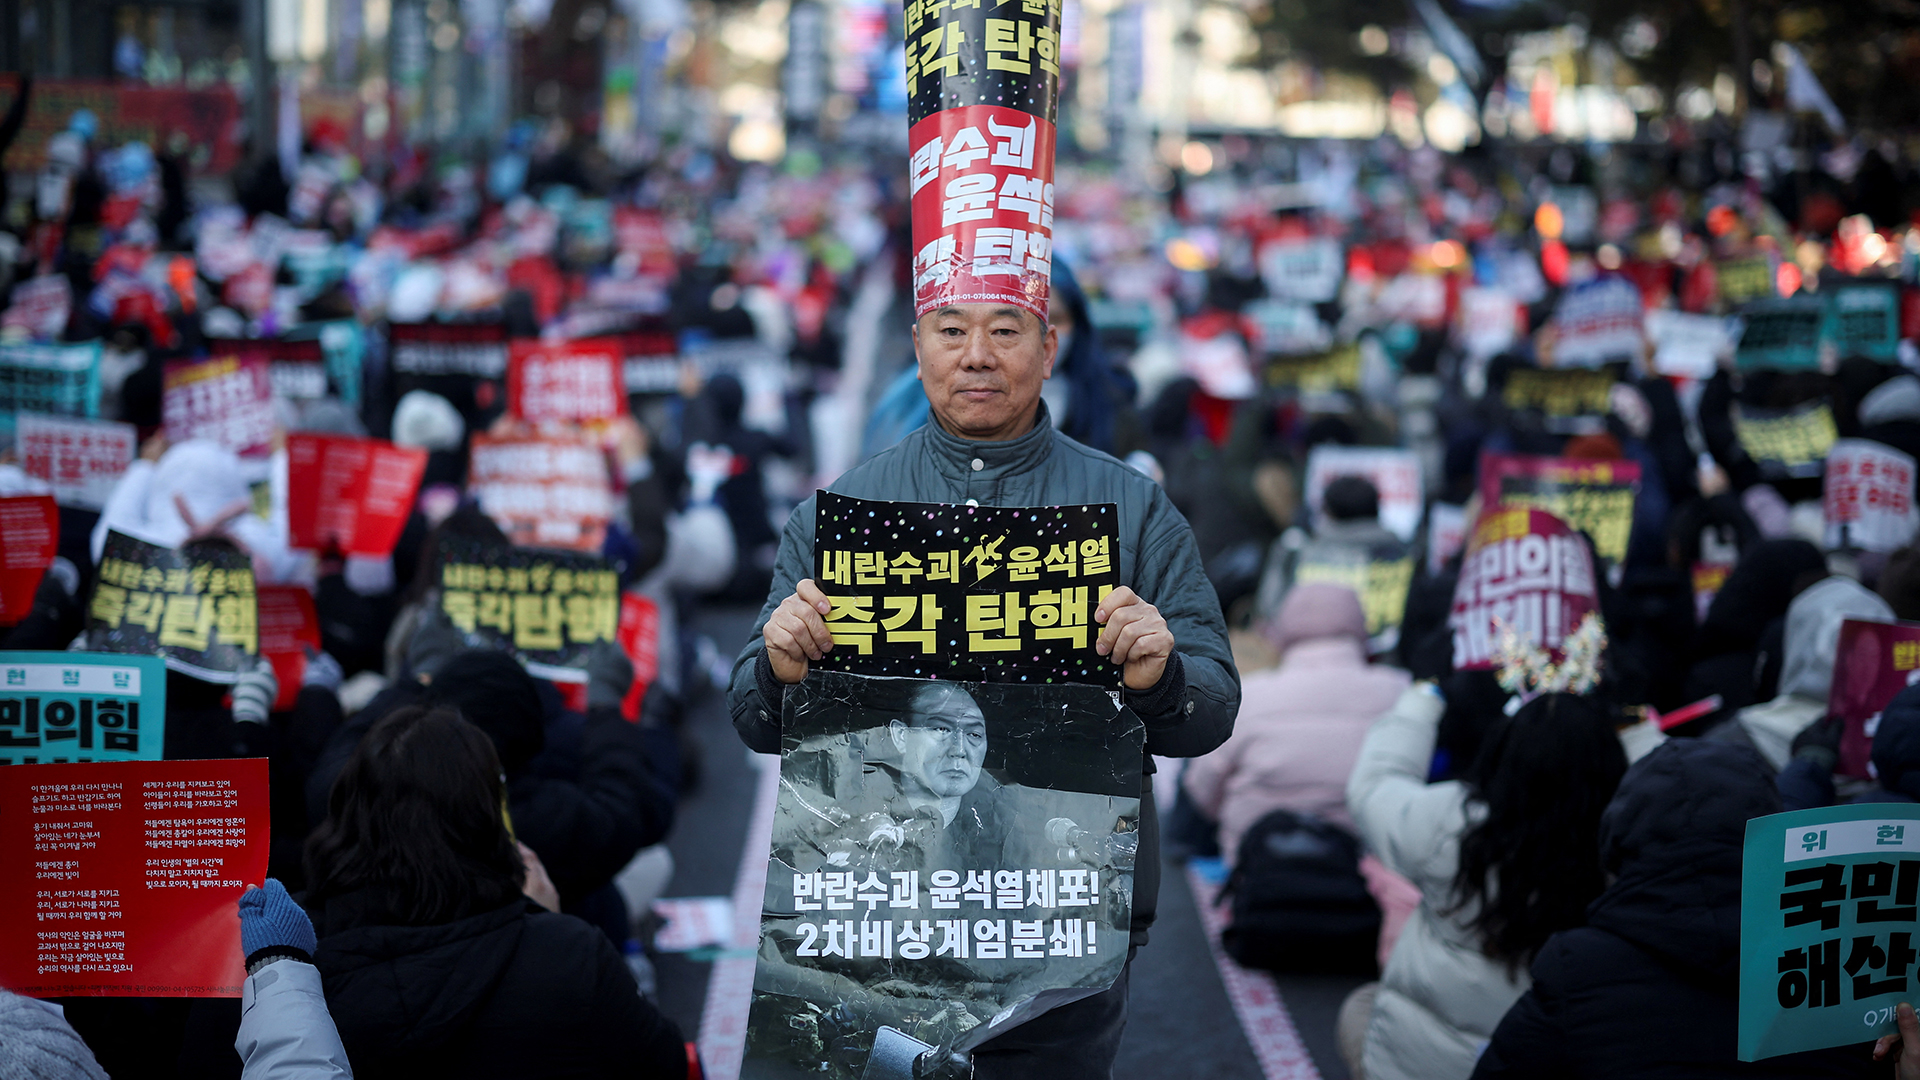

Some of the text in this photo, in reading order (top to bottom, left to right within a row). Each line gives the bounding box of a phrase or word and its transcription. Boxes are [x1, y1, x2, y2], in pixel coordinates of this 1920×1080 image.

[909, 114, 1037, 200] 란수괴
[914, 233, 957, 291] 각
[821, 534, 1112, 585] 내란수괴 윤석열
[825, 593, 943, 655] 즉각
[165, 781, 186, 789] 우리를
[216, 780, 230, 788] 있어
[77, 793, 105, 802] 반갑기도
[143, 791, 170, 799] 아이들이
[223, 790, 237, 798] 있어
[32, 805, 54, 813] 눈물과
[34, 823, 47, 831] 용기
[145, 820, 172, 828] 저들에겐
[196, 818, 223, 826] 우리에겐
[225, 818, 245, 826] 영혼이
[145, 828, 245, 838] 저들에겐 총칼이 우리에겐 사랑이
[34, 843, 49, 851] 우린
[145, 840, 172, 848] 저들에겐
[196, 839, 223, 847] 우리에겐
[225, 839, 246, 847] 희망이
[36, 861, 79, 870] 저들에겐 총이
[161, 859, 181, 867] 인생의
[36, 871, 79, 880] 우리에겐 빛이
[205, 869, 219, 877] 말고
[168, 881, 190, 889] 모이자,
[36, 891, 53, 899] 우리,
[77, 890, 97, 898] 서로를
[792, 869, 1100, 912] 반란수괴 윤석열체포!
[1779, 860, 1920, 931] 국민
[37, 902, 53, 910] 우리,
[77, 901, 97, 909] 나라를
[84, 912, 98, 920] 함께
[99, 911, 106, 920] 할
[37, 932, 58, 940] 역사의
[60, 932, 80, 940] 악인은
[794, 919, 1097, 959] 2차비상계엄분쇄!
[98, 942, 125, 950] 나오지만
[38, 954, 58, 962] 우리는
[37, 965, 58, 974] 승리의
[60, 965, 81, 973] 역사를
[1777, 932, 1920, 1009] 해산
